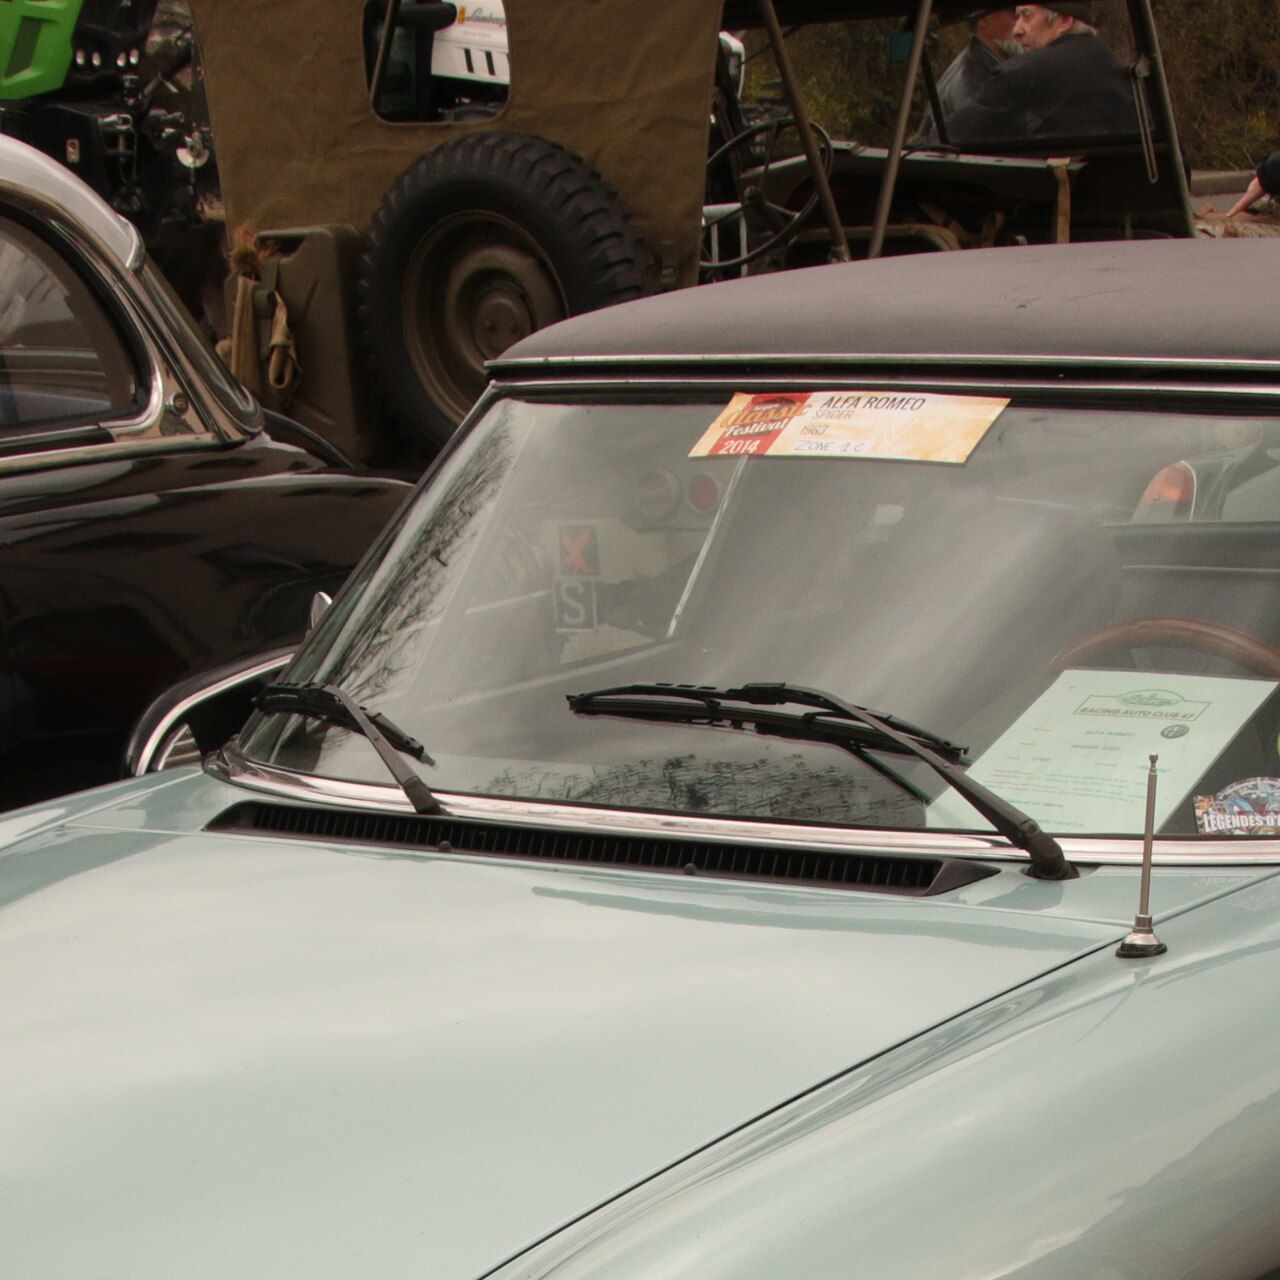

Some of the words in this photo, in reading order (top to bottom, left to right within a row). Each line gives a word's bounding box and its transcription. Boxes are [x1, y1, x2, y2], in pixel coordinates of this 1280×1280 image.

[821, 396, 860, 410] ALFA
[862, 396, 926, 411] ROMEO
[724, 418, 789, 437] Festival
[718, 440, 761, 455] 2014
[1122, 709, 1150, 717] AUTO
